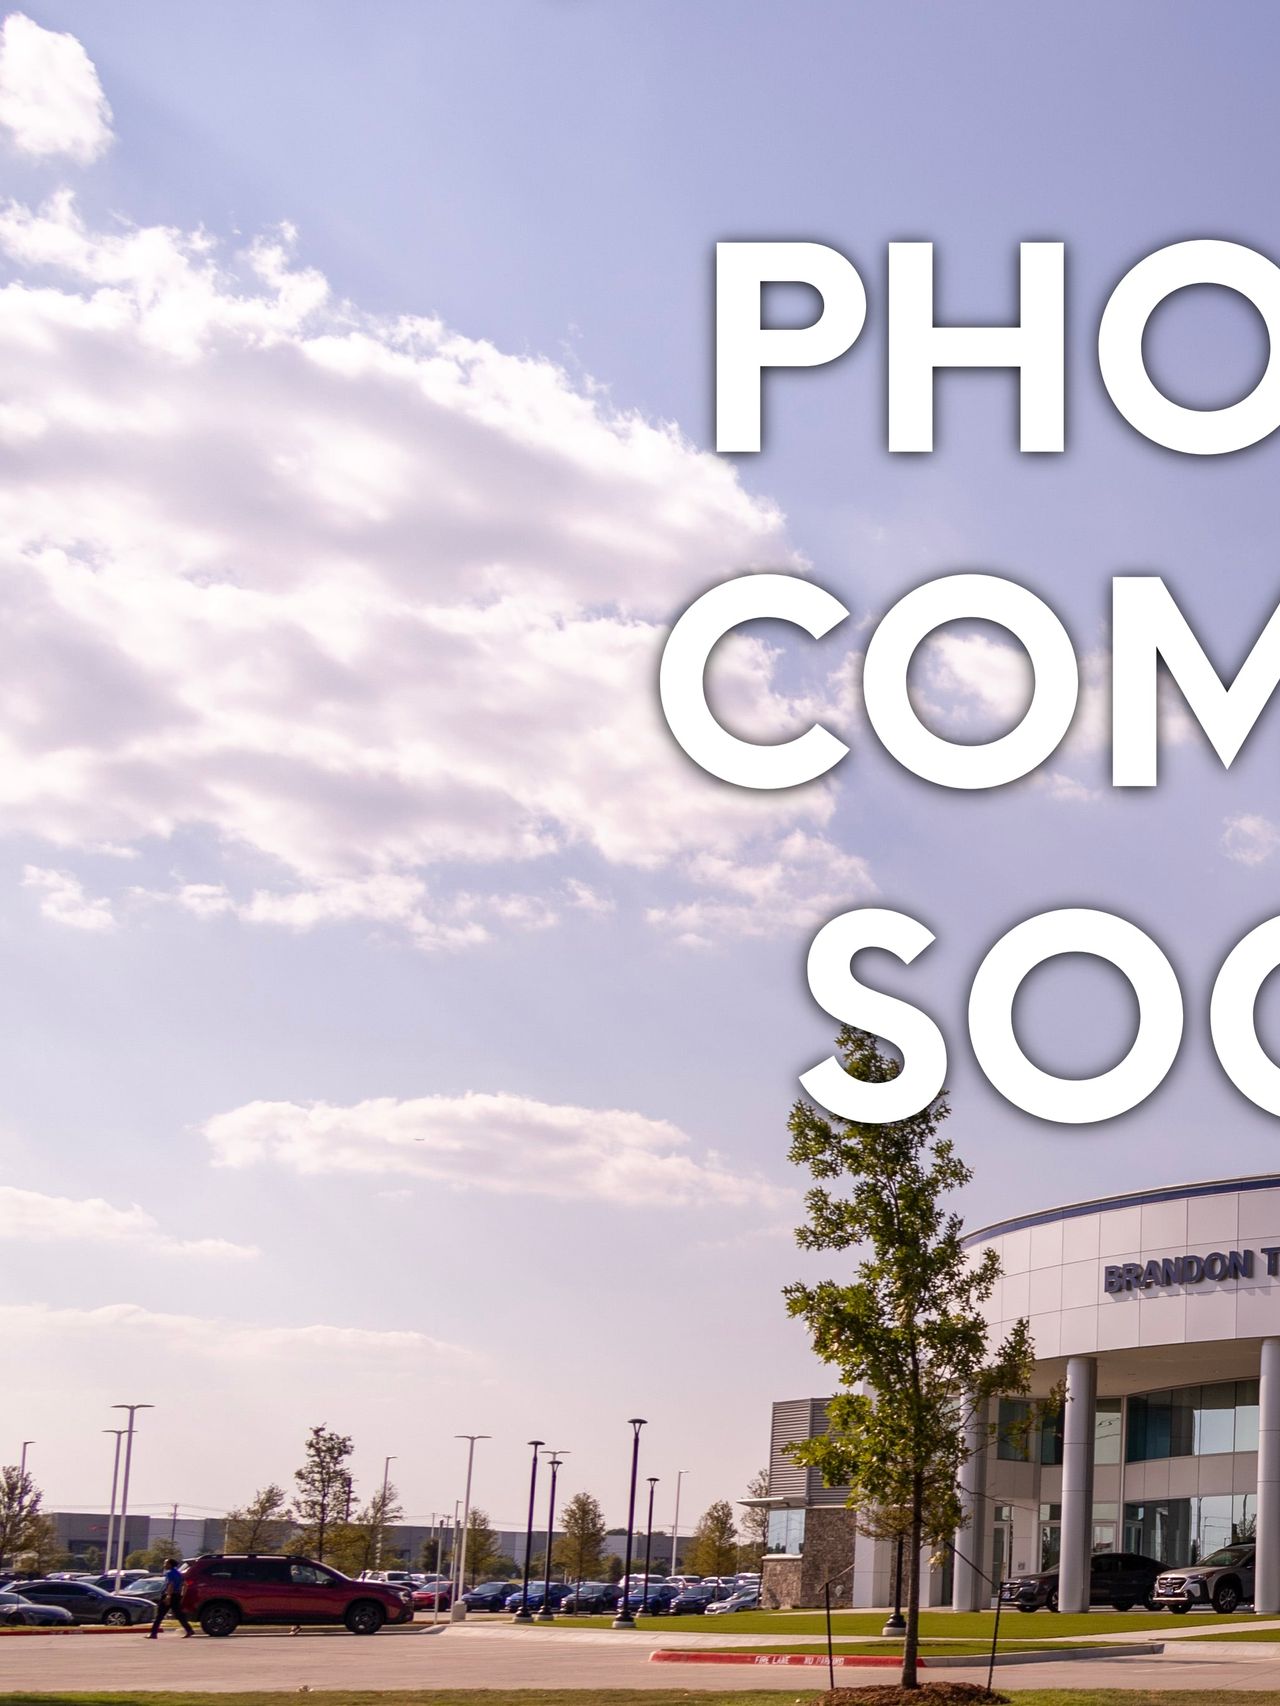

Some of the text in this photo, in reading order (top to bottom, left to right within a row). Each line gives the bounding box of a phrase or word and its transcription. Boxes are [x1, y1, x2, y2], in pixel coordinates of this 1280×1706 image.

[1104, 1249, 1253, 1293] BRANDON
[754, 1655, 845, 1666] FIRE LANE NO PARING
